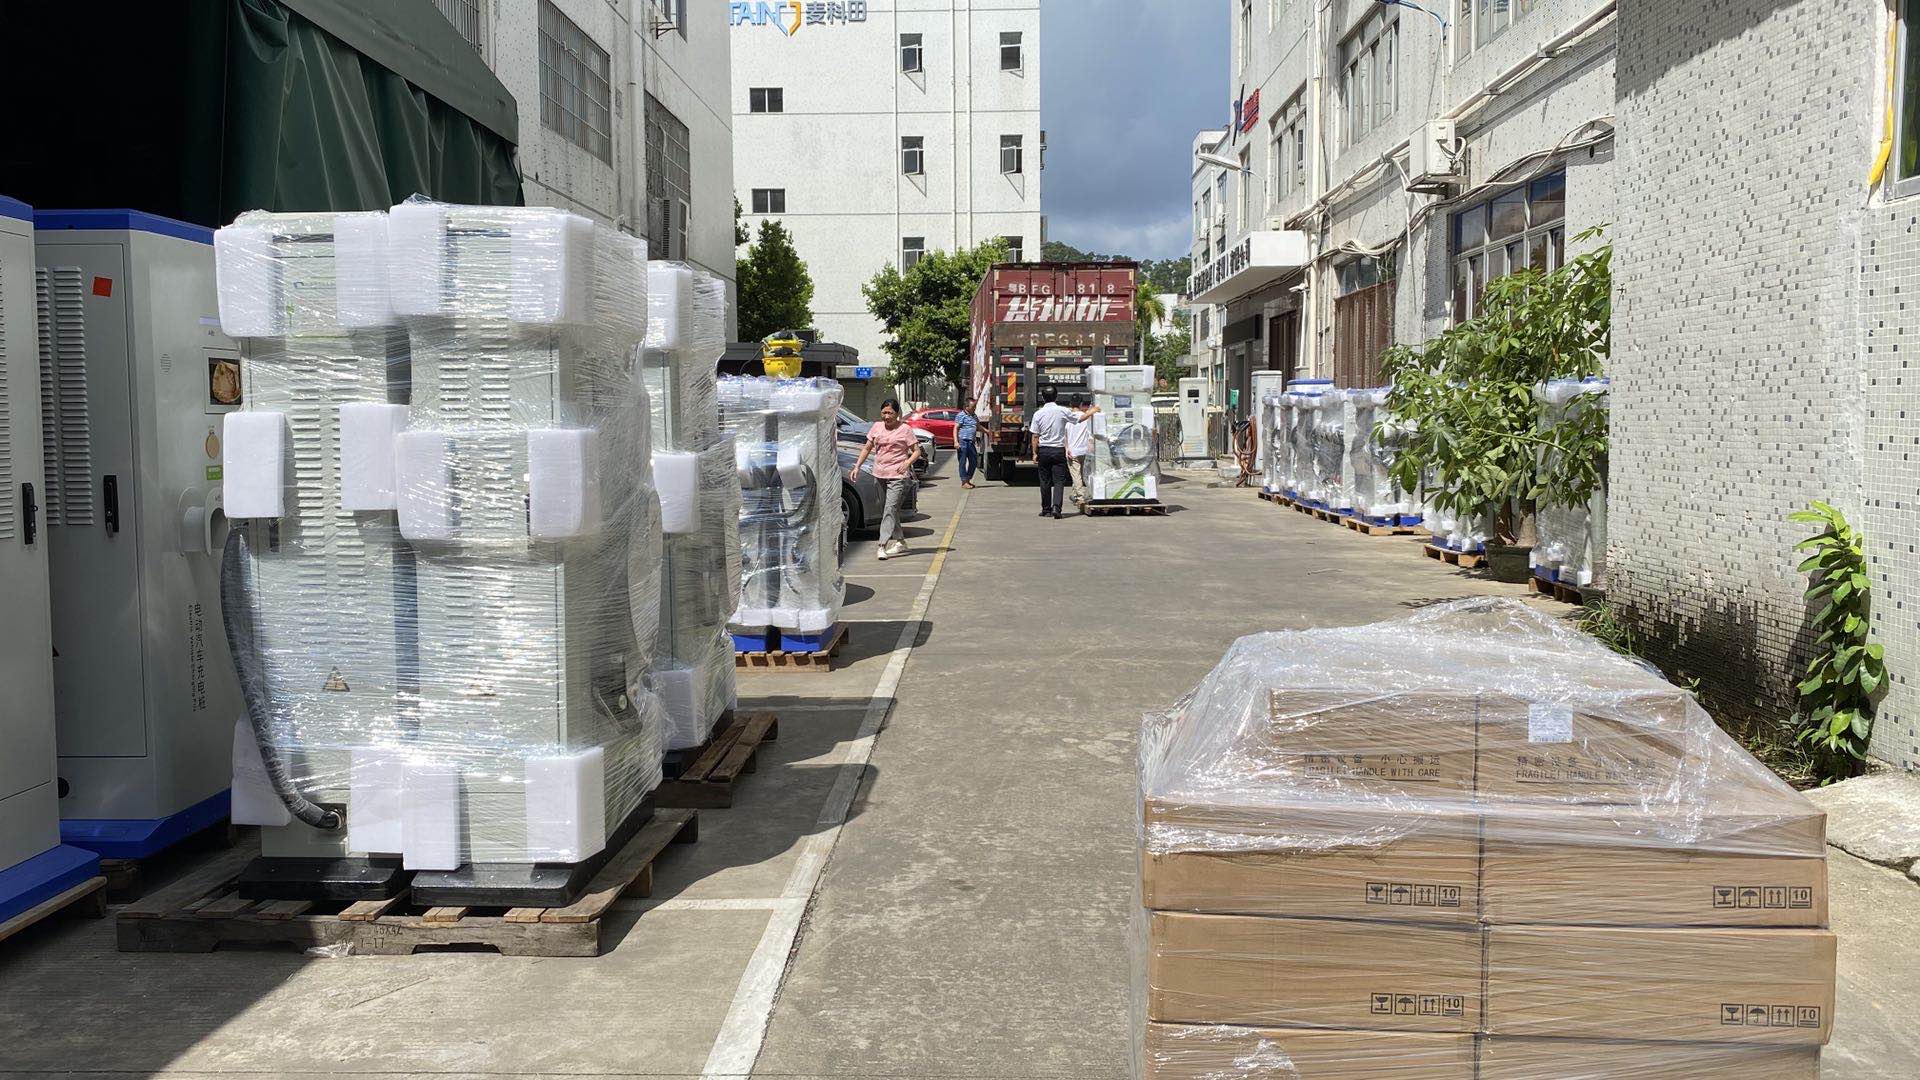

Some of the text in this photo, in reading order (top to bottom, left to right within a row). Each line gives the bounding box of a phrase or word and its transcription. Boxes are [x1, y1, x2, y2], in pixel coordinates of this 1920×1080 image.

[806, 0, 868, 26] 麦科田
[1391, 767, 1413, 777] WITH
[1418, 767, 1440, 777] CARE
[1442, 888, 1457, 899] 10
[1793, 889, 1808, 900] 10
[1445, 998, 1460, 1009] 10
[1801, 1008, 1816, 1019] 10
